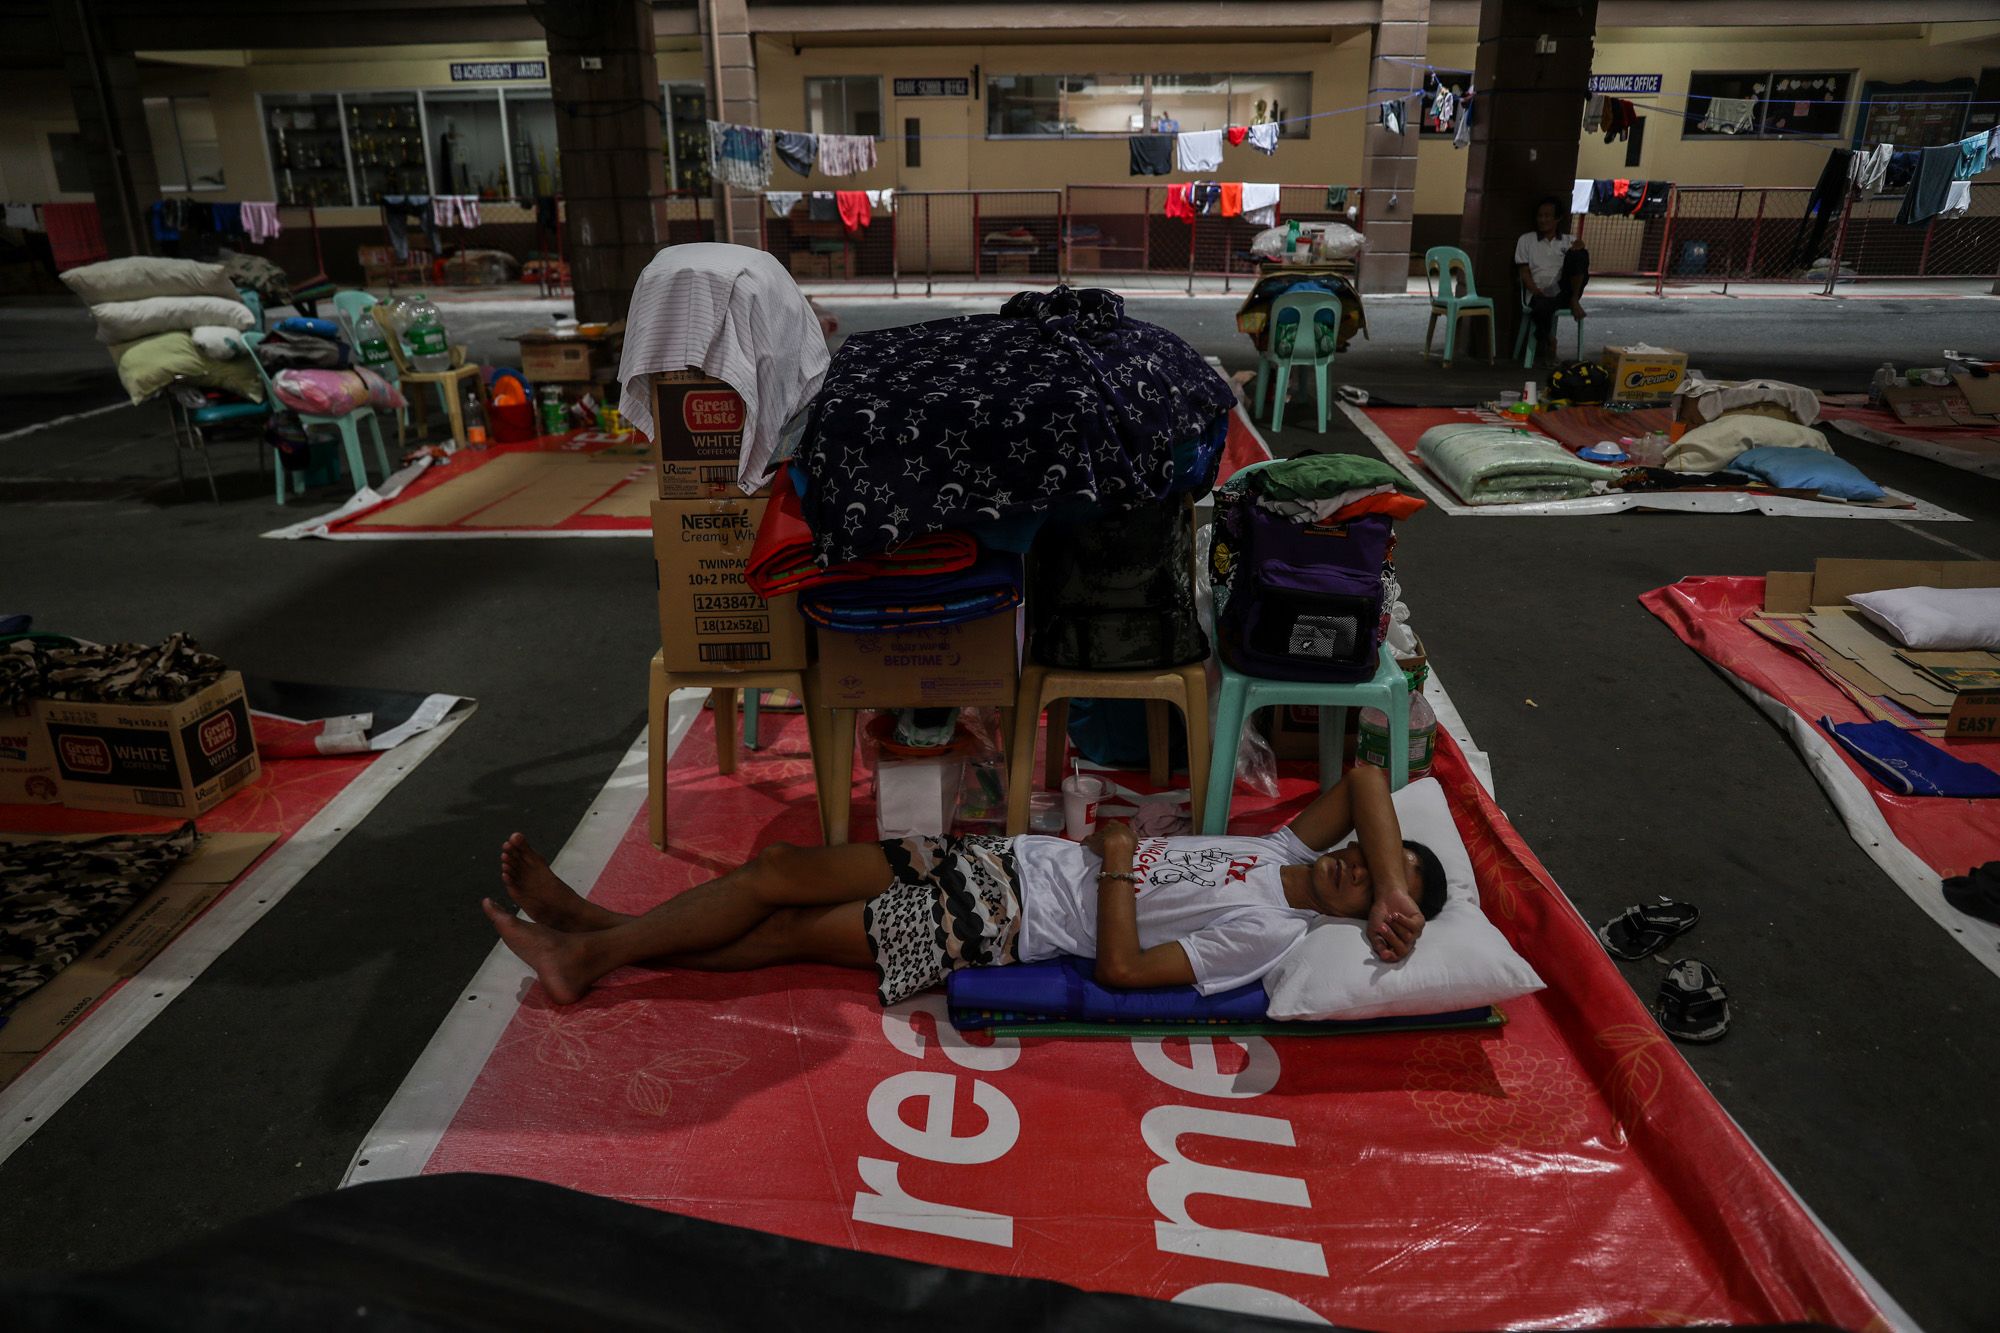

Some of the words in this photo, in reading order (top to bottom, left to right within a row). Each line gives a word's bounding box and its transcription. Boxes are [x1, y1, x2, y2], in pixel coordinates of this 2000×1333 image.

[944, 80, 967, 95] OFFICE
[1599, 76, 1634, 91] GUIDANCE
[1634, 75, 1659, 91] OFFICE
[691, 398, 737, 412] Great
[692, 411, 737, 425] Taste
[691, 434, 742, 448] WHITE
[696, 448, 724, 456] COFFEE
[681, 530, 729, 545] Creamy
[688, 573, 718, 585] 10+2
[696, 596, 766, 610] 12438471
[702, 619, 764, 633] 18(12x52g)
[884, 655, 943, 666] BEDTIME
[204, 717, 231, 739] Great
[1957, 717, 1996, 732] EASY
[206, 727, 233, 749] Taste
[65, 741, 102, 756] Great
[113, 744, 171, 763] WHITE
[208, 743, 238, 767] WHITE
[68, 753, 105, 767] Taste
